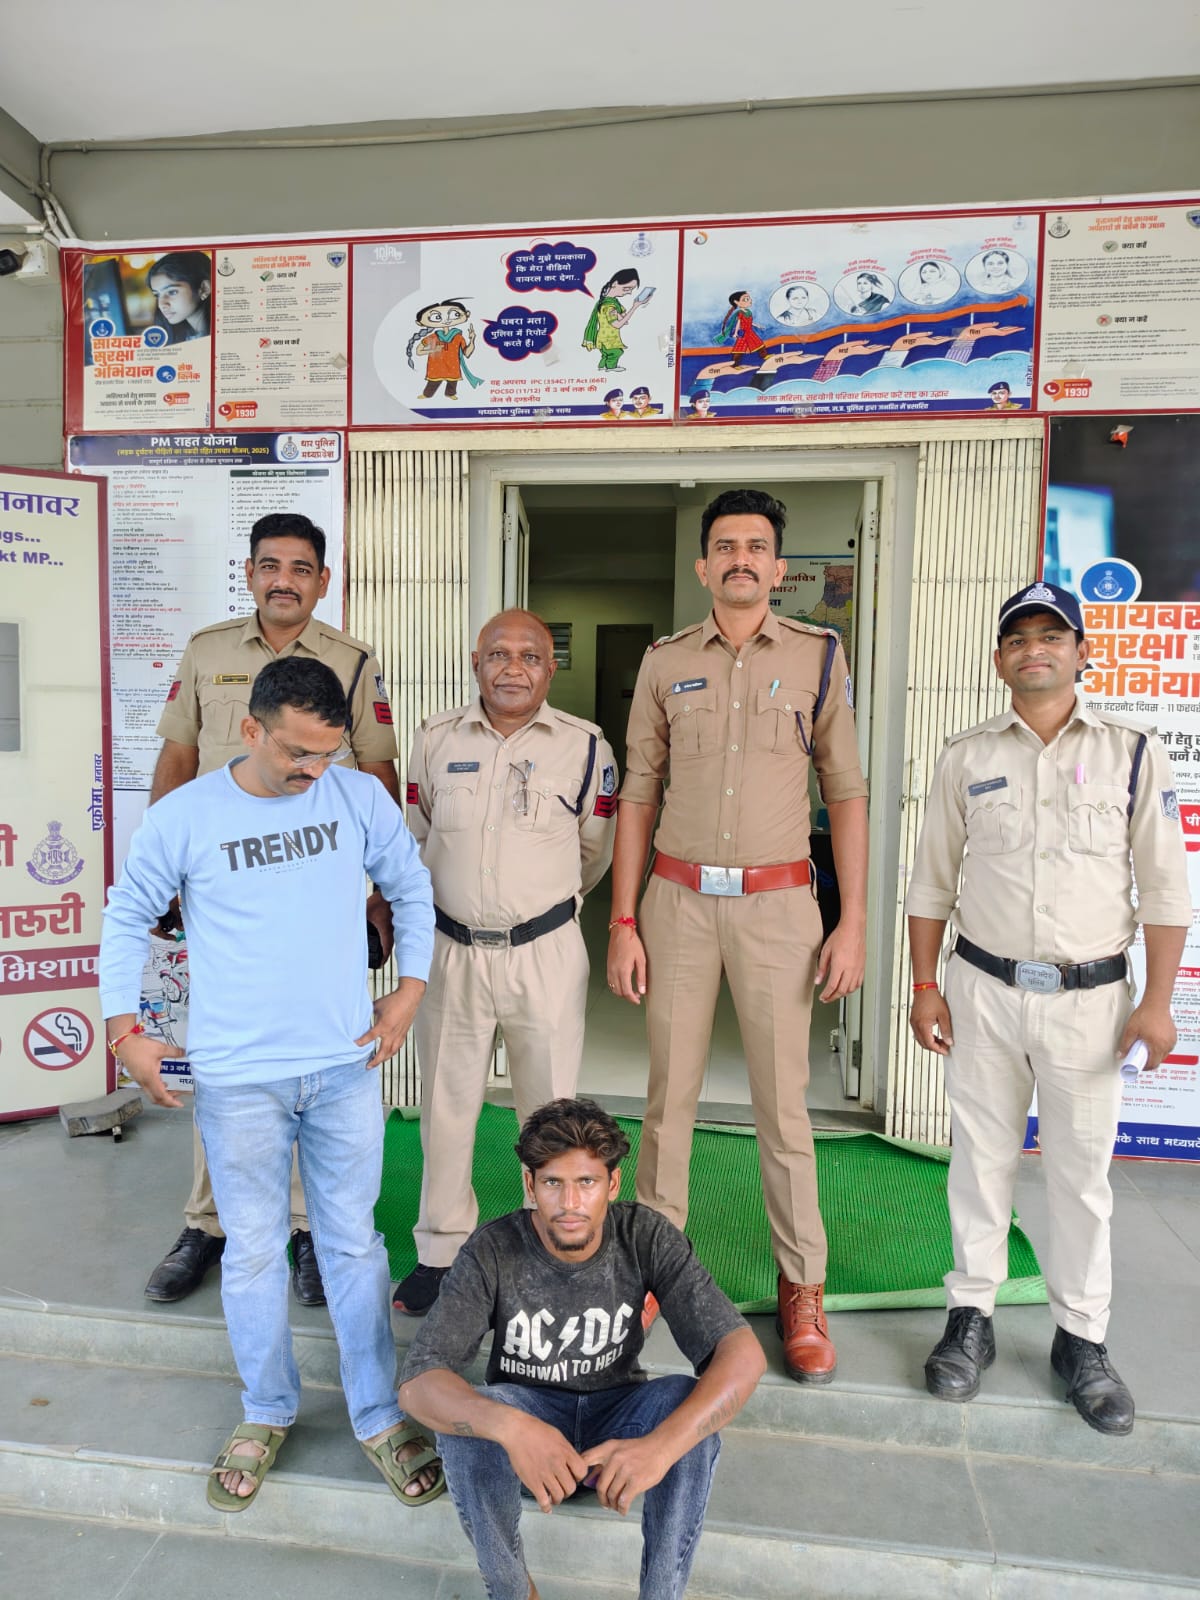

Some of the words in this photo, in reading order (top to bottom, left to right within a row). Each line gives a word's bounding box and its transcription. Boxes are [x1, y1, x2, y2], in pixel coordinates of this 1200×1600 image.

[516, 264, 526, 272] कि
[530, 264, 542, 272] मेरा
[501, 318, 523, 326] घबरा
[491, 329, 513, 340] पुलिस
[92, 336, 142, 350] सायबर
[93, 350, 135, 366] सुरक्षा
[94, 363, 155, 378] अभियान
[1064, 388, 1088, 397] 1930
[236, 409, 255, 417] 1930
[151, 438, 170, 446] PM
[174, 436, 200, 446] राहत
[204, 434, 236, 446] योजना
[301, 439, 313, 447] धार
[314, 438, 335, 449] पुलिस
[0, 530, 40, 543] gs...
[23, 552, 64, 566] MP...
[1082, 604, 1200, 630] सायबर
[1087, 634, 1188, 668] सुरक्षा
[1104, 701, 1134, 712] इंटरनेट
[1136, 701, 1158, 712] दिवस
[1168, 704, 1174, 712] 11
[1175, 732, 1193, 749] हेतु
[220, 820, 338, 872] TRENDY
[1136, 1136, 1160, 1145] साथ
[502, 1310, 556, 1362] AC
[580, 1302, 634, 1356] DC
[500, 1356, 568, 1382] HIGHWAY
[572, 1359, 592, 1376] TO
[594, 1344, 624, 1372] HELL
